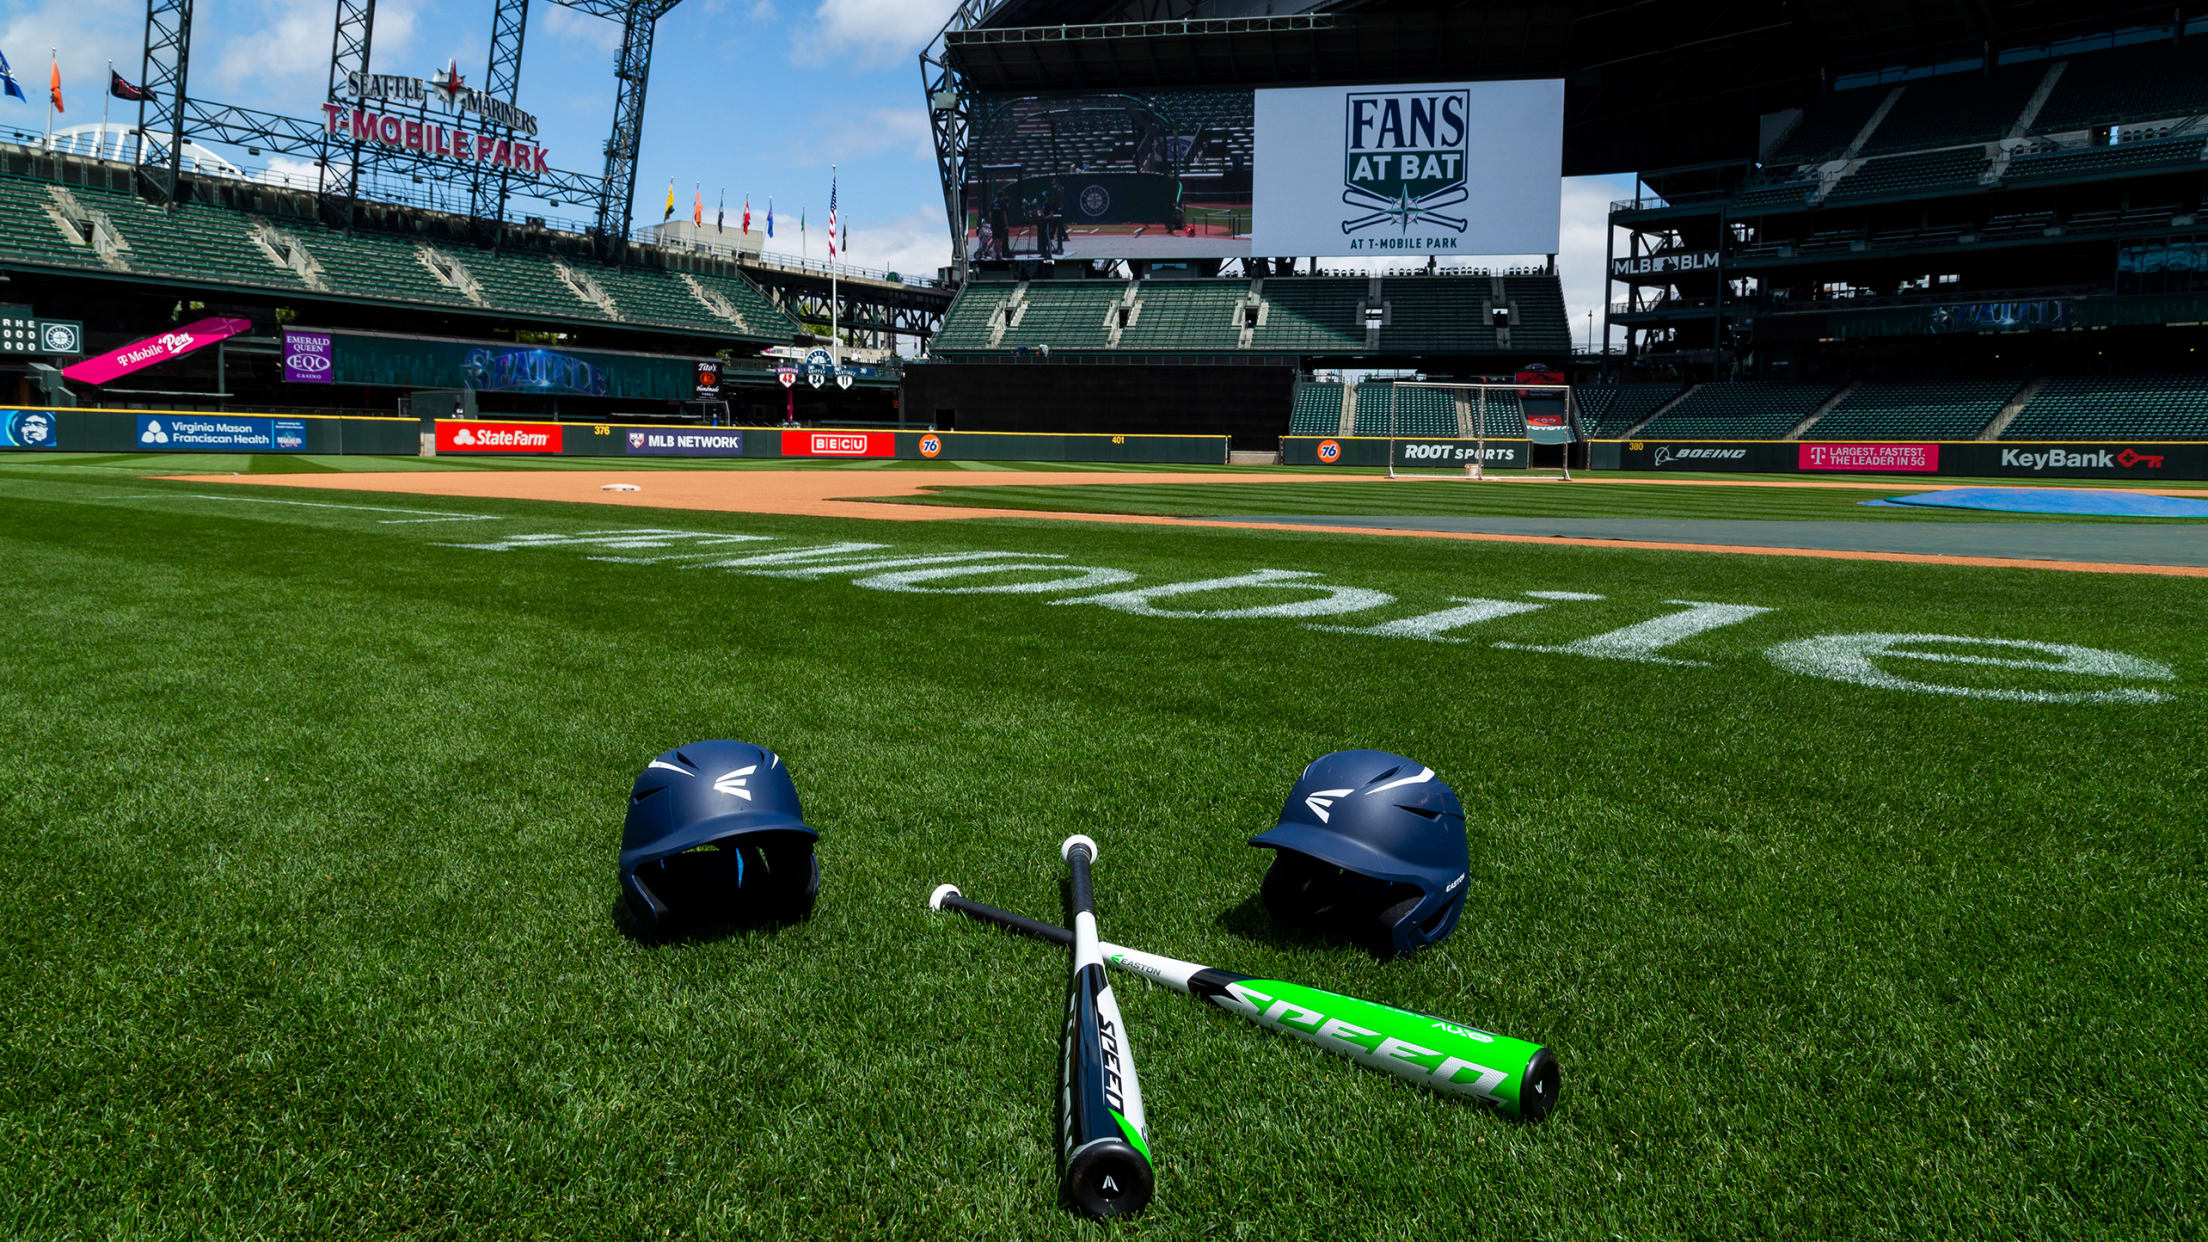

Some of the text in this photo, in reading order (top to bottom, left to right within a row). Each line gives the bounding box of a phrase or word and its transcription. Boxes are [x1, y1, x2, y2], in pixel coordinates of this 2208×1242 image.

[347, 71, 539, 136] SEATTLE MARINERS
[1351, 95, 1464, 149] FANS
[321, 102, 549, 174] T-MOBILE PARK
[1352, 154, 1460, 181] AT BAT
[1350, 237, 1457, 249] AT T-MOBILE PARK
[1614, 252, 1719, 275] MLB BLM
[2, 319, 36, 329] R H E
[286, 335, 330, 346] EMERALD
[127, 345, 163, 363] Mobile
[158, 332, 194, 354] Pen
[293, 343, 324, 353] QUEEN
[783, 374, 792, 383] 42
[171, 421, 252, 434] Virginia Mason
[594, 425, 611, 436] 376
[173, 433, 233, 444] Franciscan
[233, 435, 270, 445] Health
[648, 435, 739, 448] MLB NETWORK
[815, 438, 863, 450] BECU
[1112, 436, 1125, 444] 401
[923, 439, 938, 452] 76
[1320, 445, 1337, 457] 76
[1629, 442, 1644, 451] 380
[1405, 444, 1515, 460] ROOT SPORTS
[1675, 448, 1747, 458] BOEING
[1830, 447, 1926, 457] LARGEST. FASTEST.
[1830, 456, 1926, 466] THE LEADER IN 5G
[2001, 448, 2115, 471] KeyBank
[1120, 958, 1161, 977] EASTON
[1208, 976, 1510, 1107] SPEED
[1098, 1012, 1125, 1118] SPEED
